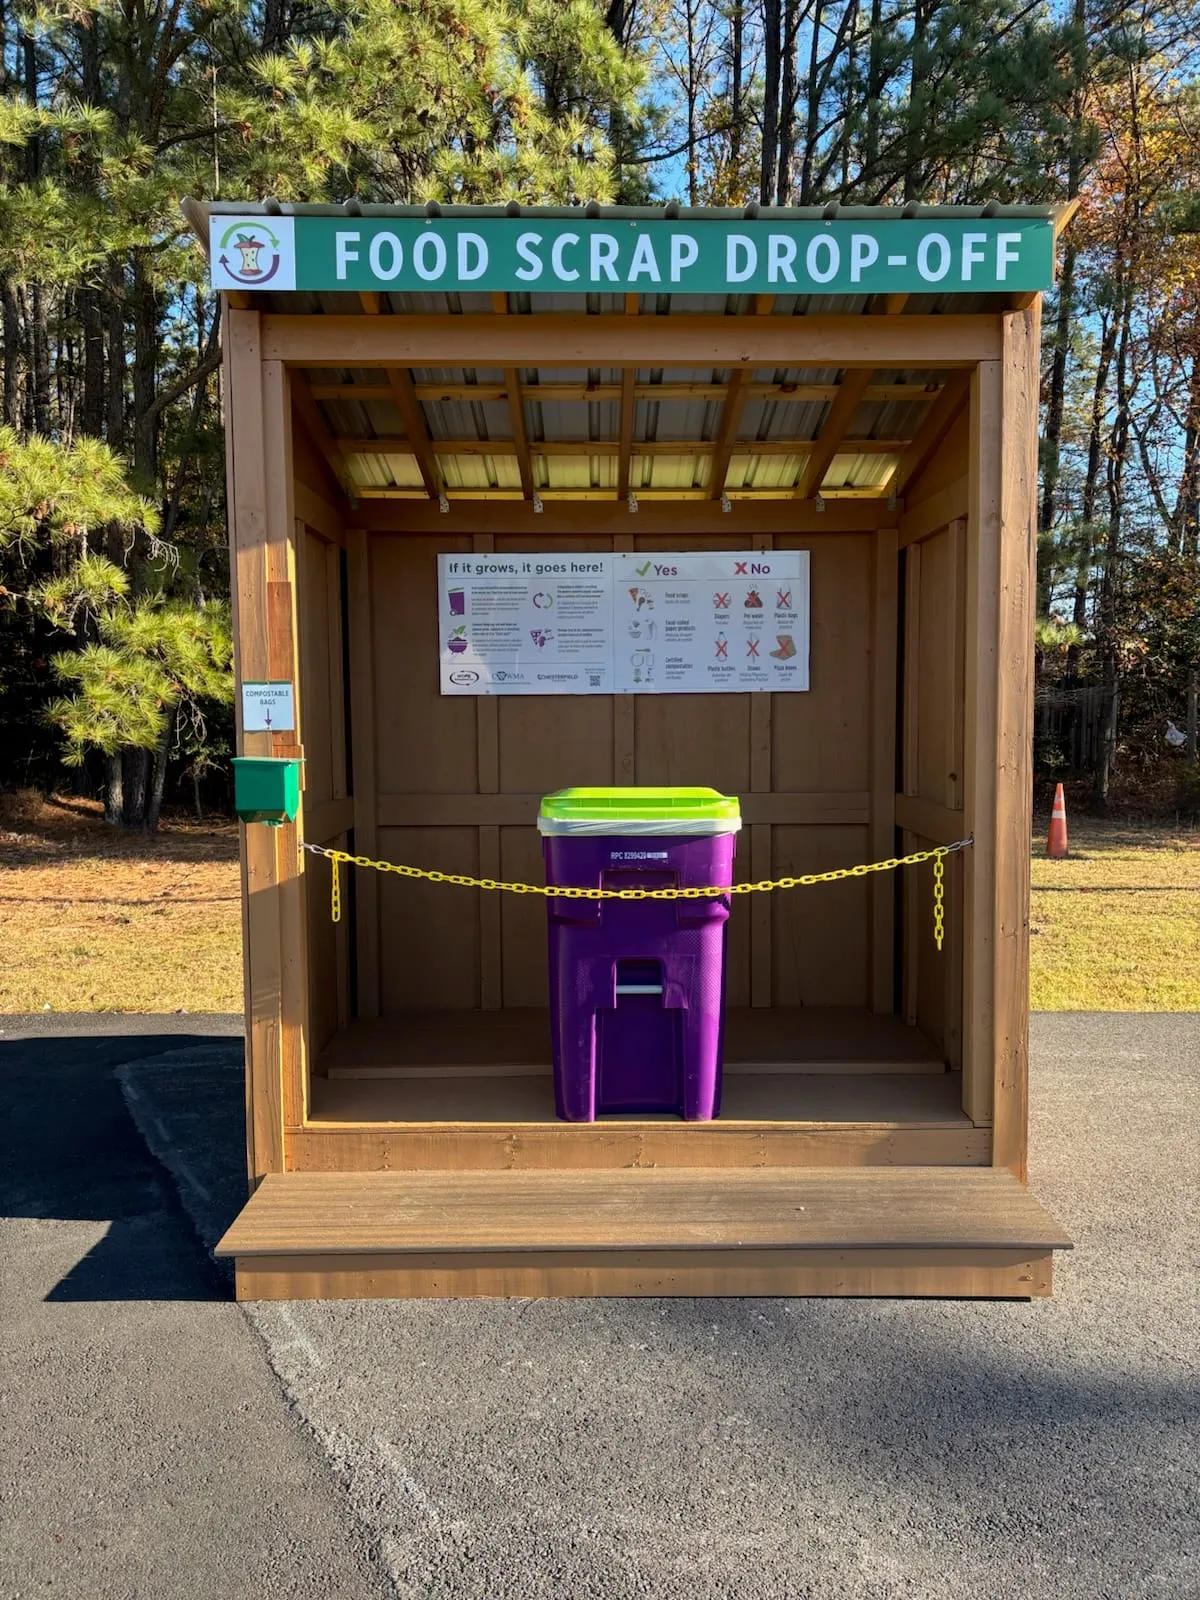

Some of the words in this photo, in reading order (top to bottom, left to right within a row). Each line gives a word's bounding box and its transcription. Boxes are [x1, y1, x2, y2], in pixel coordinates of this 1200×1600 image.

[335, 229, 489, 282] FOOD
[514, 230, 699, 283] SCRAP
[725, 230, 1022, 284] DROP-OFF
[449, 562, 461, 573] If
[462, 563, 471, 573] it
[475, 563, 518, 575] grows,
[522, 563, 531, 573] it
[535, 564, 566, 575] goes
[570, 562, 604, 573] here!
[653, 564, 678, 576] Yes
[751, 563, 771, 575] No
